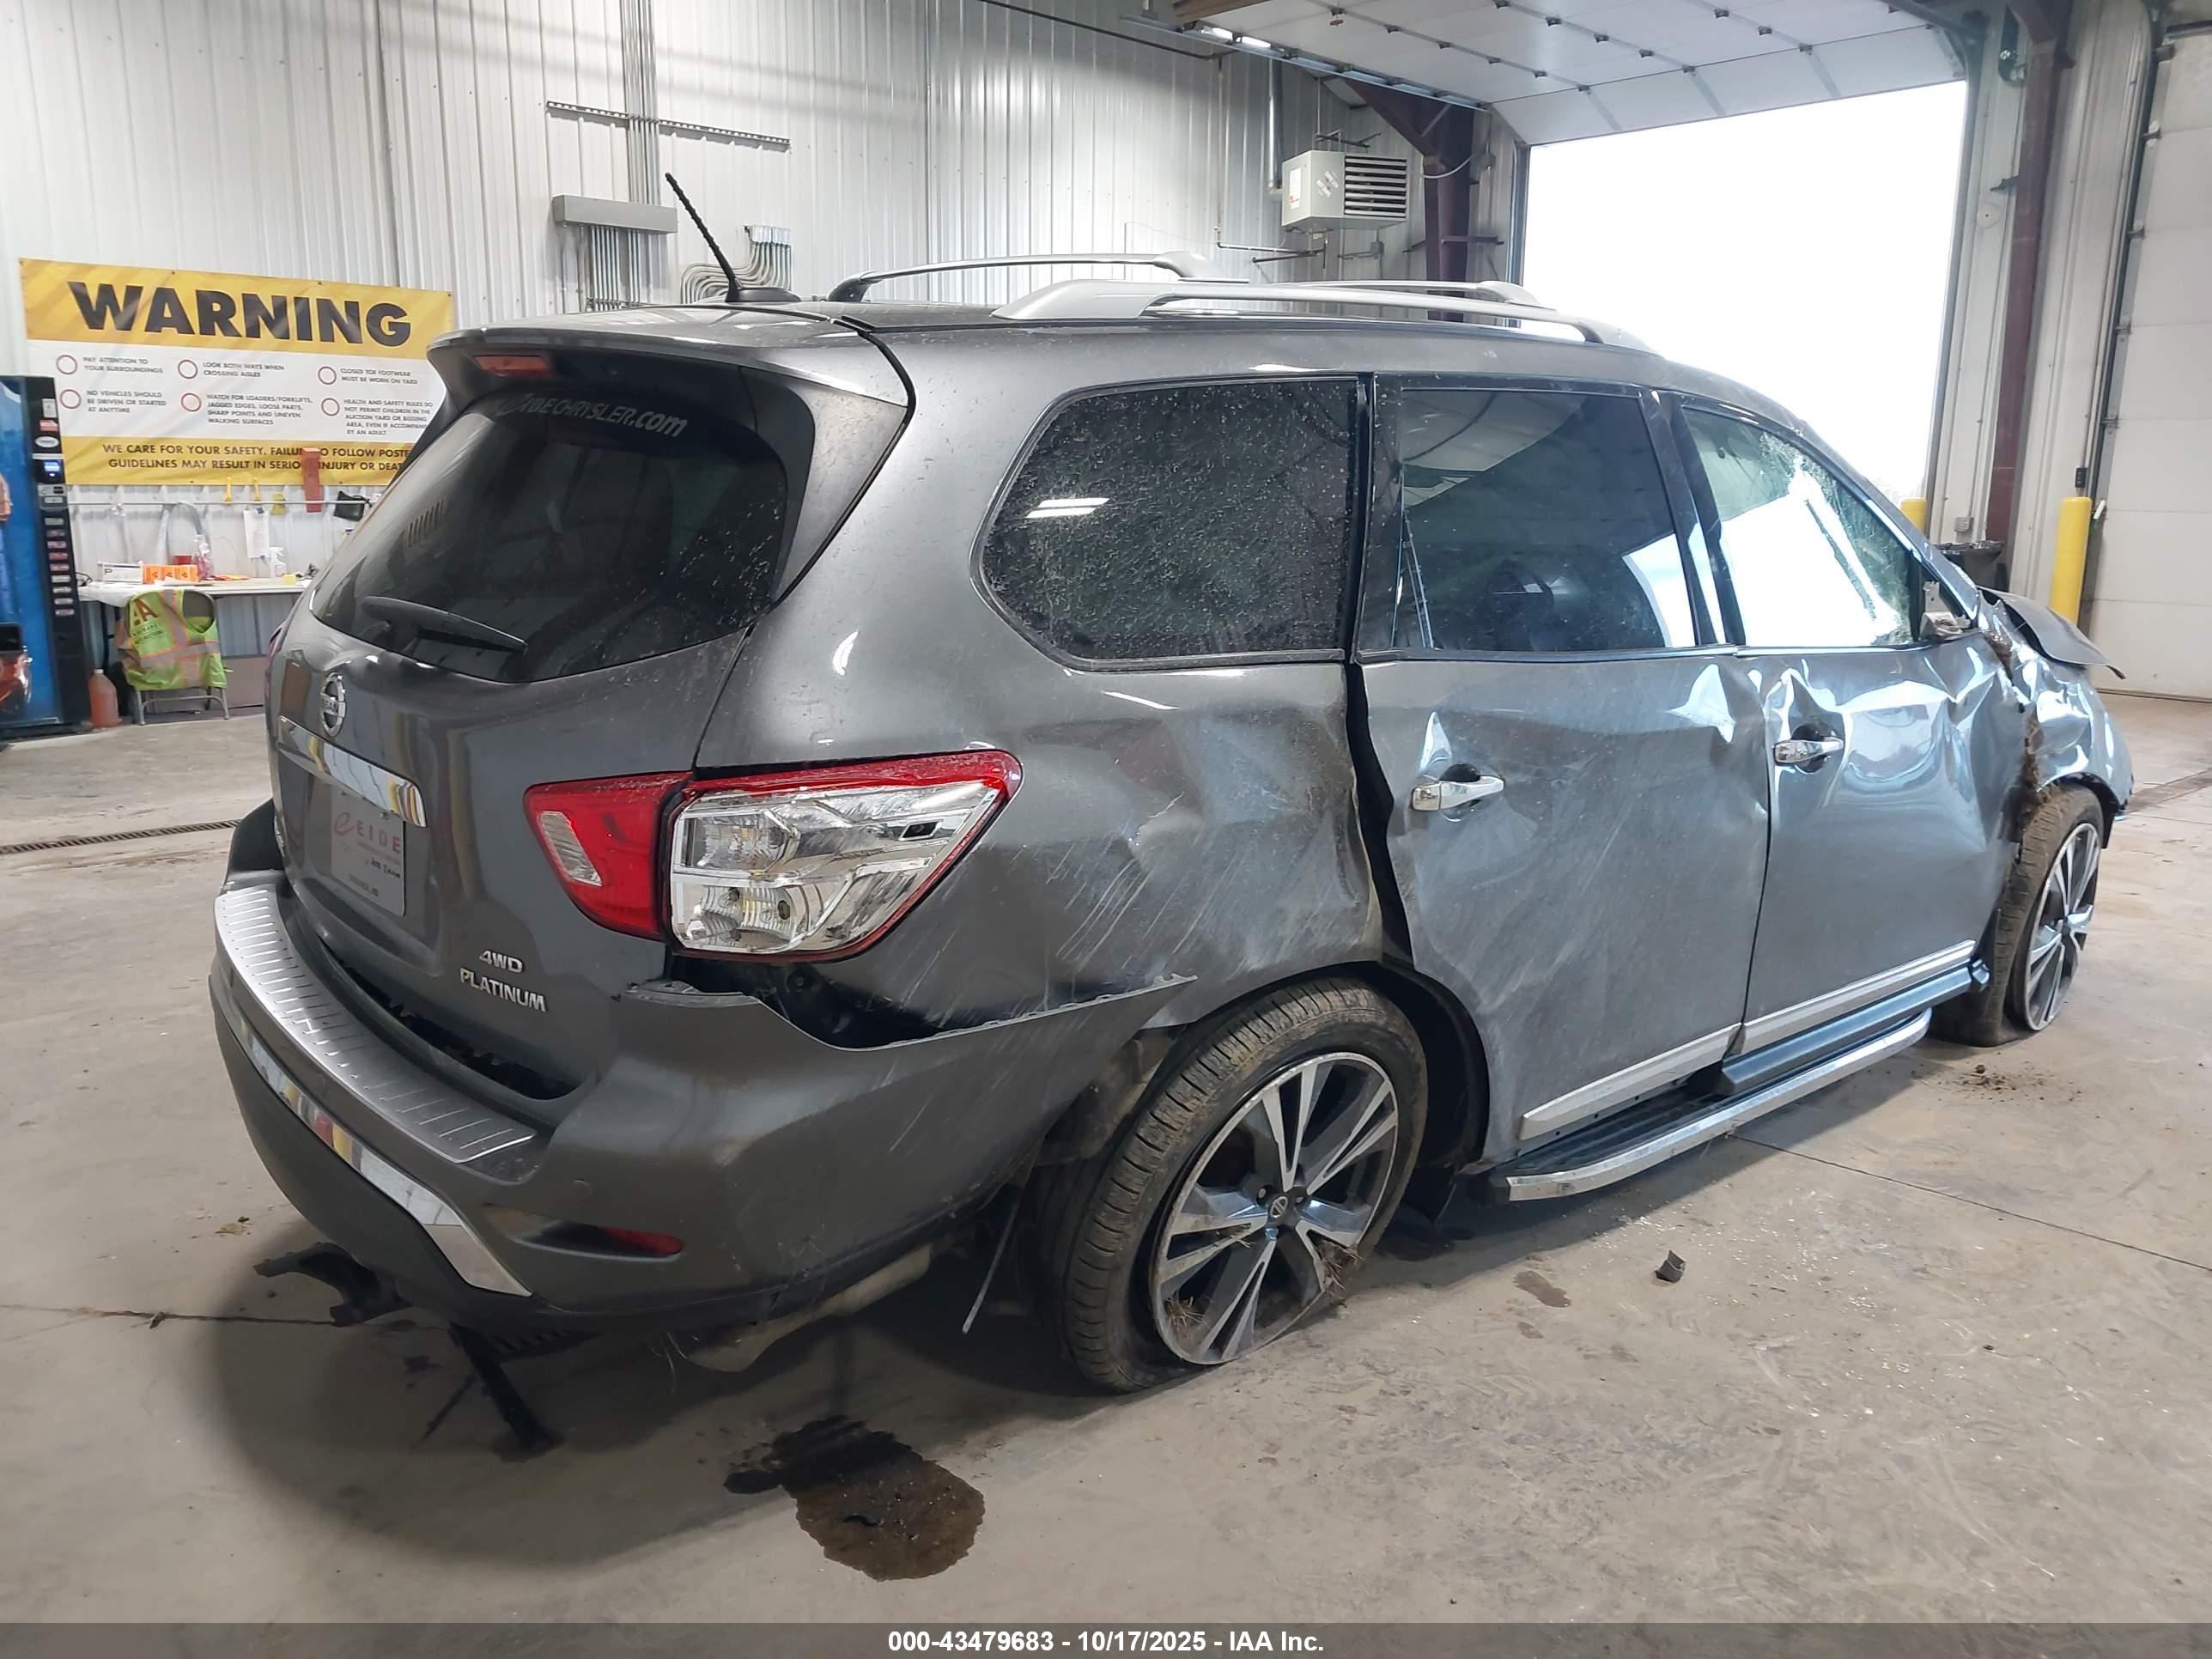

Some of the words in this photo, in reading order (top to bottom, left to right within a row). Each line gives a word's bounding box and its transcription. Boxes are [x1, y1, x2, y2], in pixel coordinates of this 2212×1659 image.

[67, 281, 412, 347] WARNING
[103, 444, 123, 453] WE
[126, 445, 155, 454] CARE
[161, 445, 183, 454] FOR
[187, 446, 220, 455] YOUR
[224, 447, 267, 456] SAFETY.
[319, 447, 330, 456] O
[332, 448, 375, 458] FOLLOW
[379, 449, 411, 458] POSTE
[108, 459, 178, 469] GUIDELINES
[181, 459, 208, 469] MAY
[212, 460, 249, 470] RESULT
[253, 461, 266, 470] IN
[269, 460, 301, 470] SERIO
[359, 462, 375, 471] OR
[356, 820, 401, 854] EIDE
[479, 950, 523, 973] 4WD
[460, 968, 547, 1012] PLATINUM
